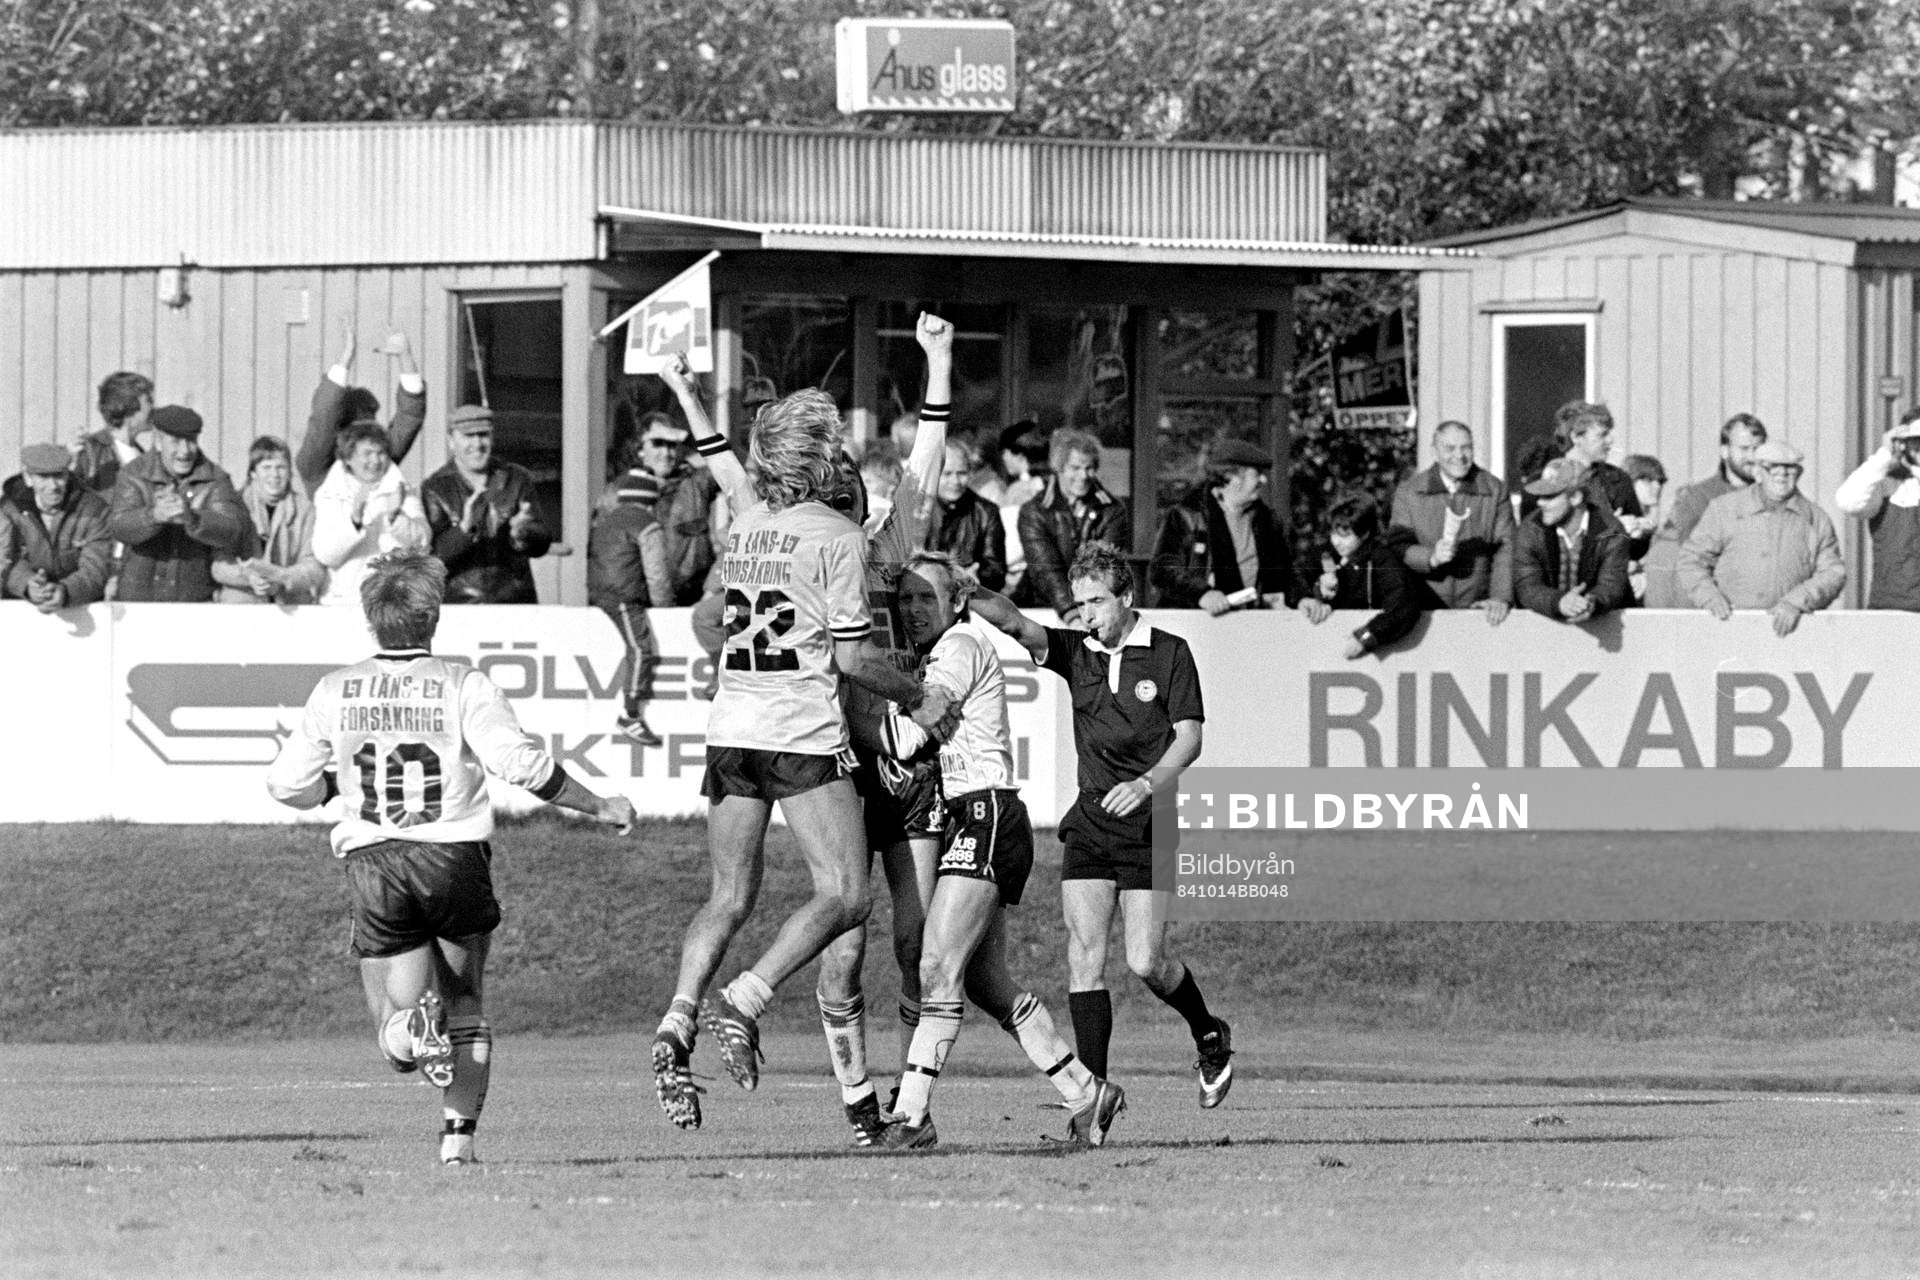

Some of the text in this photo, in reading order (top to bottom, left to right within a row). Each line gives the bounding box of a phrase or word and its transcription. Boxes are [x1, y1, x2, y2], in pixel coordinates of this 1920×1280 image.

[940, 46, 1007, 97] glass
[725, 588, 800, 672] 22
[1308, 671, 1875, 769] RINKABY
[353, 742, 442, 829] 10
[973, 801, 986, 820] 8
